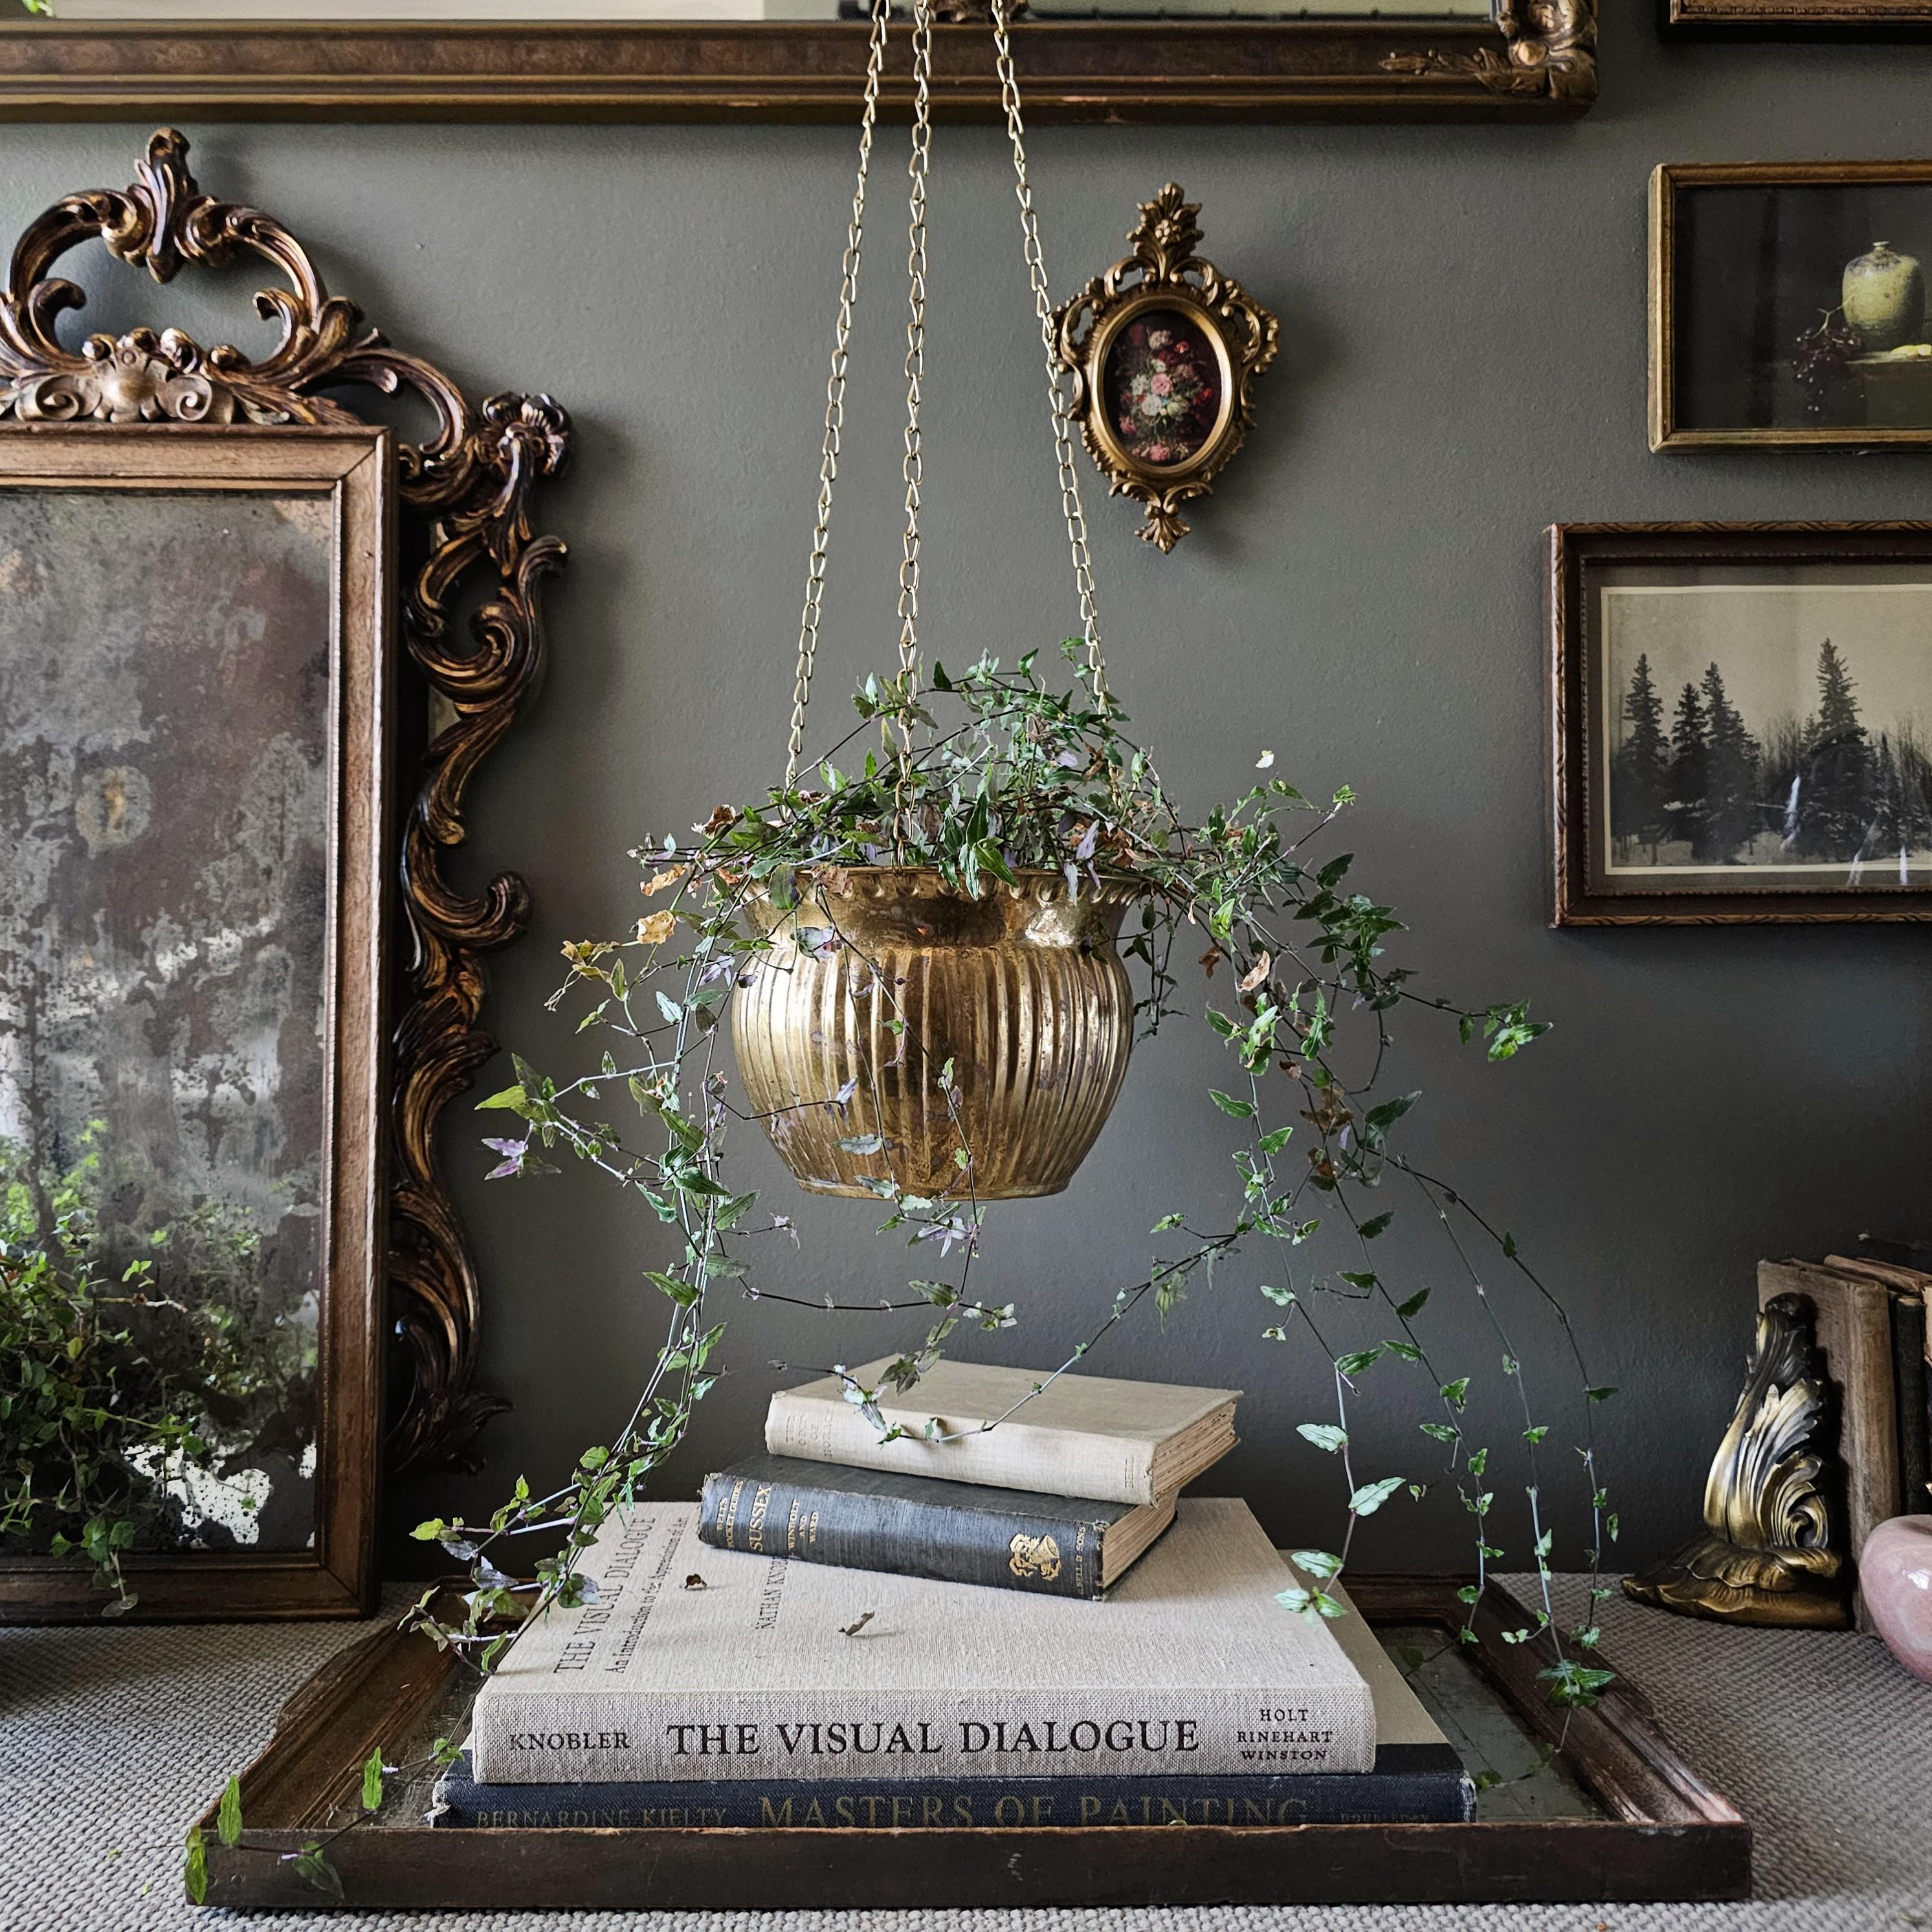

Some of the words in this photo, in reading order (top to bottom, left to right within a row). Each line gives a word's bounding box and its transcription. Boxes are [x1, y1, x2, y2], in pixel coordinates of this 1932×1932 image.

[729, 1480, 744, 1512] GUIDES
[716, 1496, 728, 1532] BELL'S
[725, 1511, 735, 1549] POCKET
[749, 1483, 773, 1553] SUSSEX
[788, 1493, 800, 1550] WINBOLT
[798, 1515, 808, 1539] AND
[808, 1511, 819, 1544] WARD
[604, 1517, 656, 1579] DIALOGUE
[766, 1558, 789, 1585] KNOB
[573, 1584, 624, 1636] VISUAL
[755, 1588, 782, 1630] NATHAN
[613, 1605, 652, 1657] Introduction
[553, 1641, 597, 1674] THE
[605, 1656, 629, 1674] An
[1260, 1709, 1309, 1722] HOLT
[509, 1732, 631, 1750] KNOBLER
[667, 1724, 761, 1755] THE
[776, 1722, 943, 1755] VISUAL
[959, 1720, 1200, 1753] DIALOGUE
[1236, 1731, 1333, 1744] RINEHART
[1240, 1749, 1328, 1761] WINSTON
[477, 1809, 632, 1828] BERNARDINE
[642, 1807, 727, 1828] KIELTY
[758, 1795, 972, 1828] MASTERS
[994, 1795, 1056, 1828] OF
[1078, 1795, 1307, 1827] PAINTING
